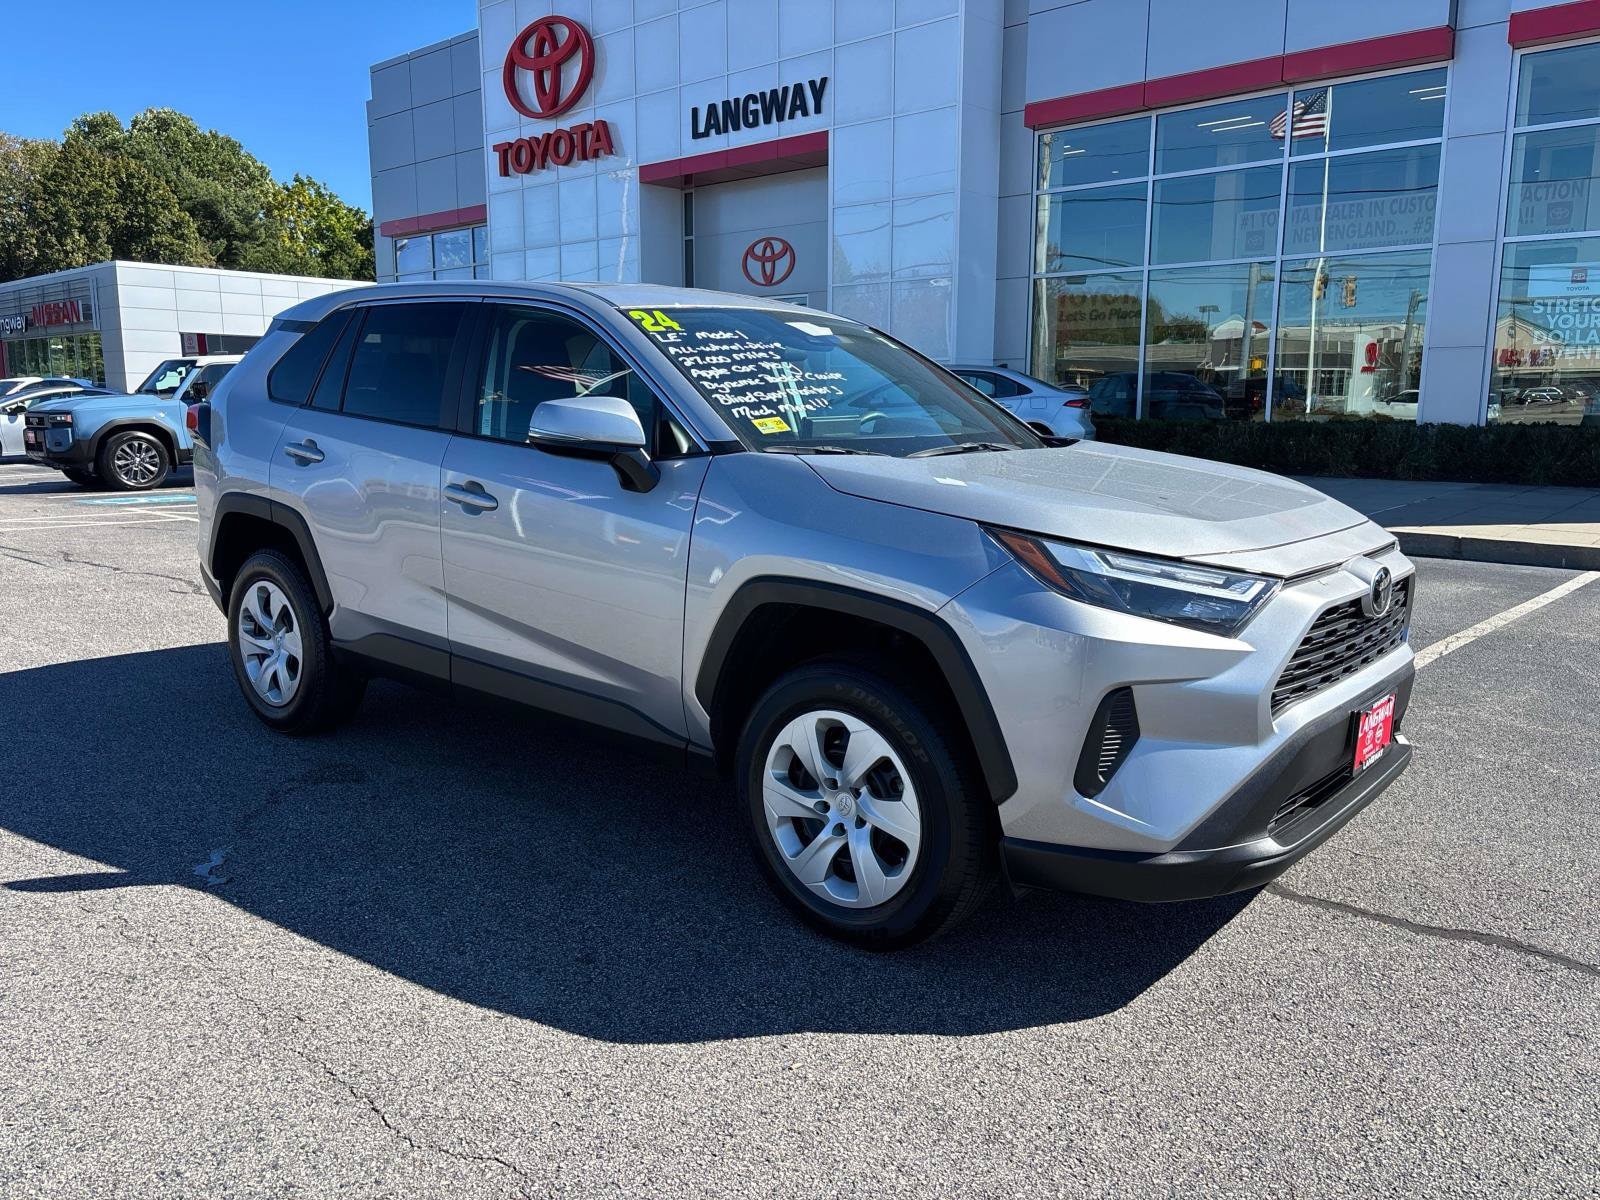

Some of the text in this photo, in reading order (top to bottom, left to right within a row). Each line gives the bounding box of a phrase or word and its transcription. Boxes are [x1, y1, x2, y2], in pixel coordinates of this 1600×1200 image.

[691, 77, 829, 140] LANGWAY
[493, 119, 614, 178] TOYOTA
[1369, 200, 1385, 218] IN
[32, 300, 83, 326] NISSAN
[629, 310, 681, 331] 24
[1089, 308, 1106, 321] Go
[731, 404, 777, 419] Much
